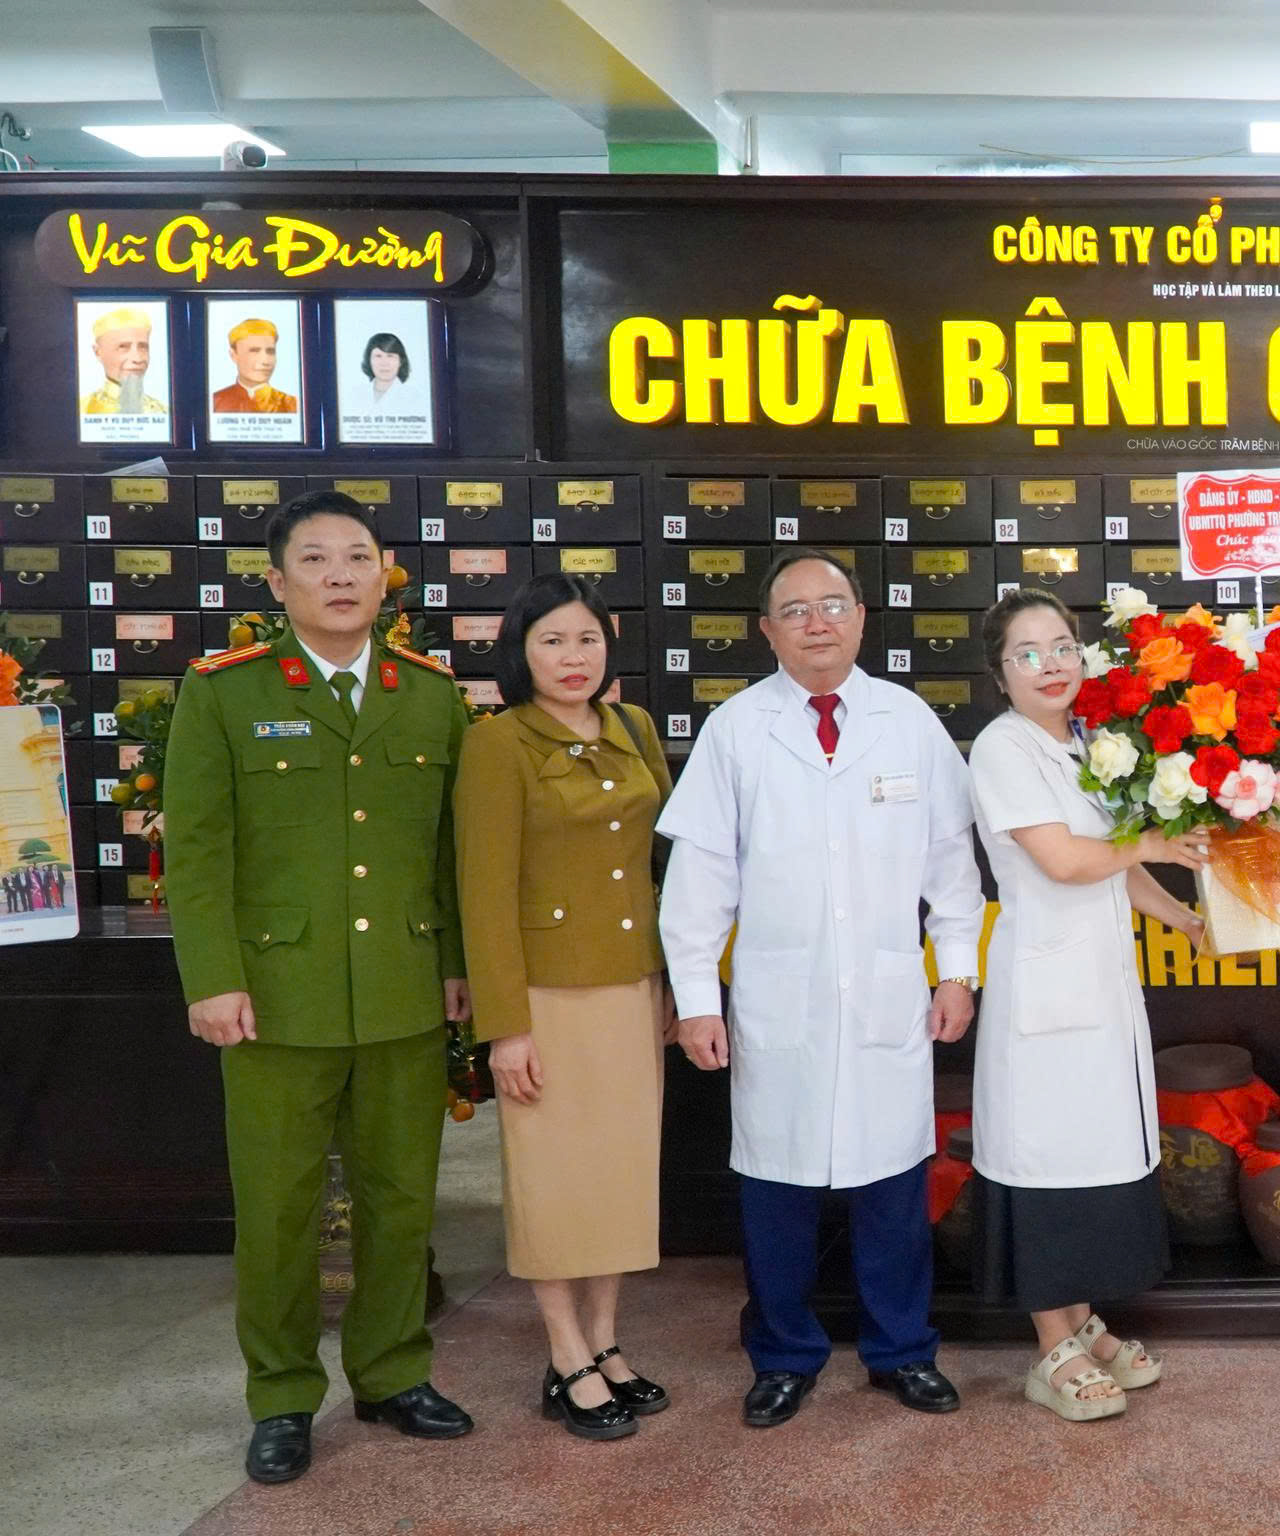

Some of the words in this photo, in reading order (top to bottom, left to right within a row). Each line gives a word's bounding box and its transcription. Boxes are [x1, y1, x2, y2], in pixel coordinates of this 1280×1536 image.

[992, 215, 1099, 264] CÔNG
[1110, 226, 1153, 264] TY
[1166, 203, 1223, 264] CỔ
[69, 213, 147, 274] Vũ
[156, 215, 258, 283] Gia
[264, 216, 443, 283] Đường
[1153, 284, 1176, 299] HỌC
[1179, 281, 1199, 299] TẬP
[1201, 281, 1216, 297] VÀ
[1218, 281, 1242, 297] LÀM
[1245, 284, 1272, 297] THEO
[609, 294, 908, 427] CHỮA
[942, 297, 1229, 447] BỆNH
[1127, 436, 1159, 450] CHỮA
[1161, 436, 1187, 450] VÀO
[1188, 435, 1217, 450] GỐC
[1220, 437, 1250, 451] TRĂM
[1251, 438, 1280, 453] BỆNH
[1199, 488, 1225, 507] ĐẢNG
[1227, 486, 1239, 505] ỦY
[92, 520, 107, 534] 10
[667, 520, 682, 534] 55
[1189, 515, 1226, 531] UBMTTQ
[1228, 509, 1265, 528] PHƯỜNG
[204, 522, 218, 536] 19
[425, 523, 440, 537] 37
[537, 523, 552, 537] 46
[779, 522, 794, 536] 64
[890, 523, 904, 537] 73
[999, 523, 1014, 537] 82
[1109, 521, 1123, 535] 91
[1216, 534, 1249, 546] Chúc
[94, 587, 108, 601] 11
[204, 589, 220, 603] 20
[428, 588, 443, 602] 38
[667, 587, 682, 601] 56
[893, 588, 908, 603] 74
[1219, 586, 1237, 599] 101
[97, 653, 111, 667] 12
[670, 653, 685, 667] 57
[892, 653, 906, 668] 75
[99, 718, 113, 732] 13
[672, 718, 687, 733] 58
[104, 848, 118, 862] 15
